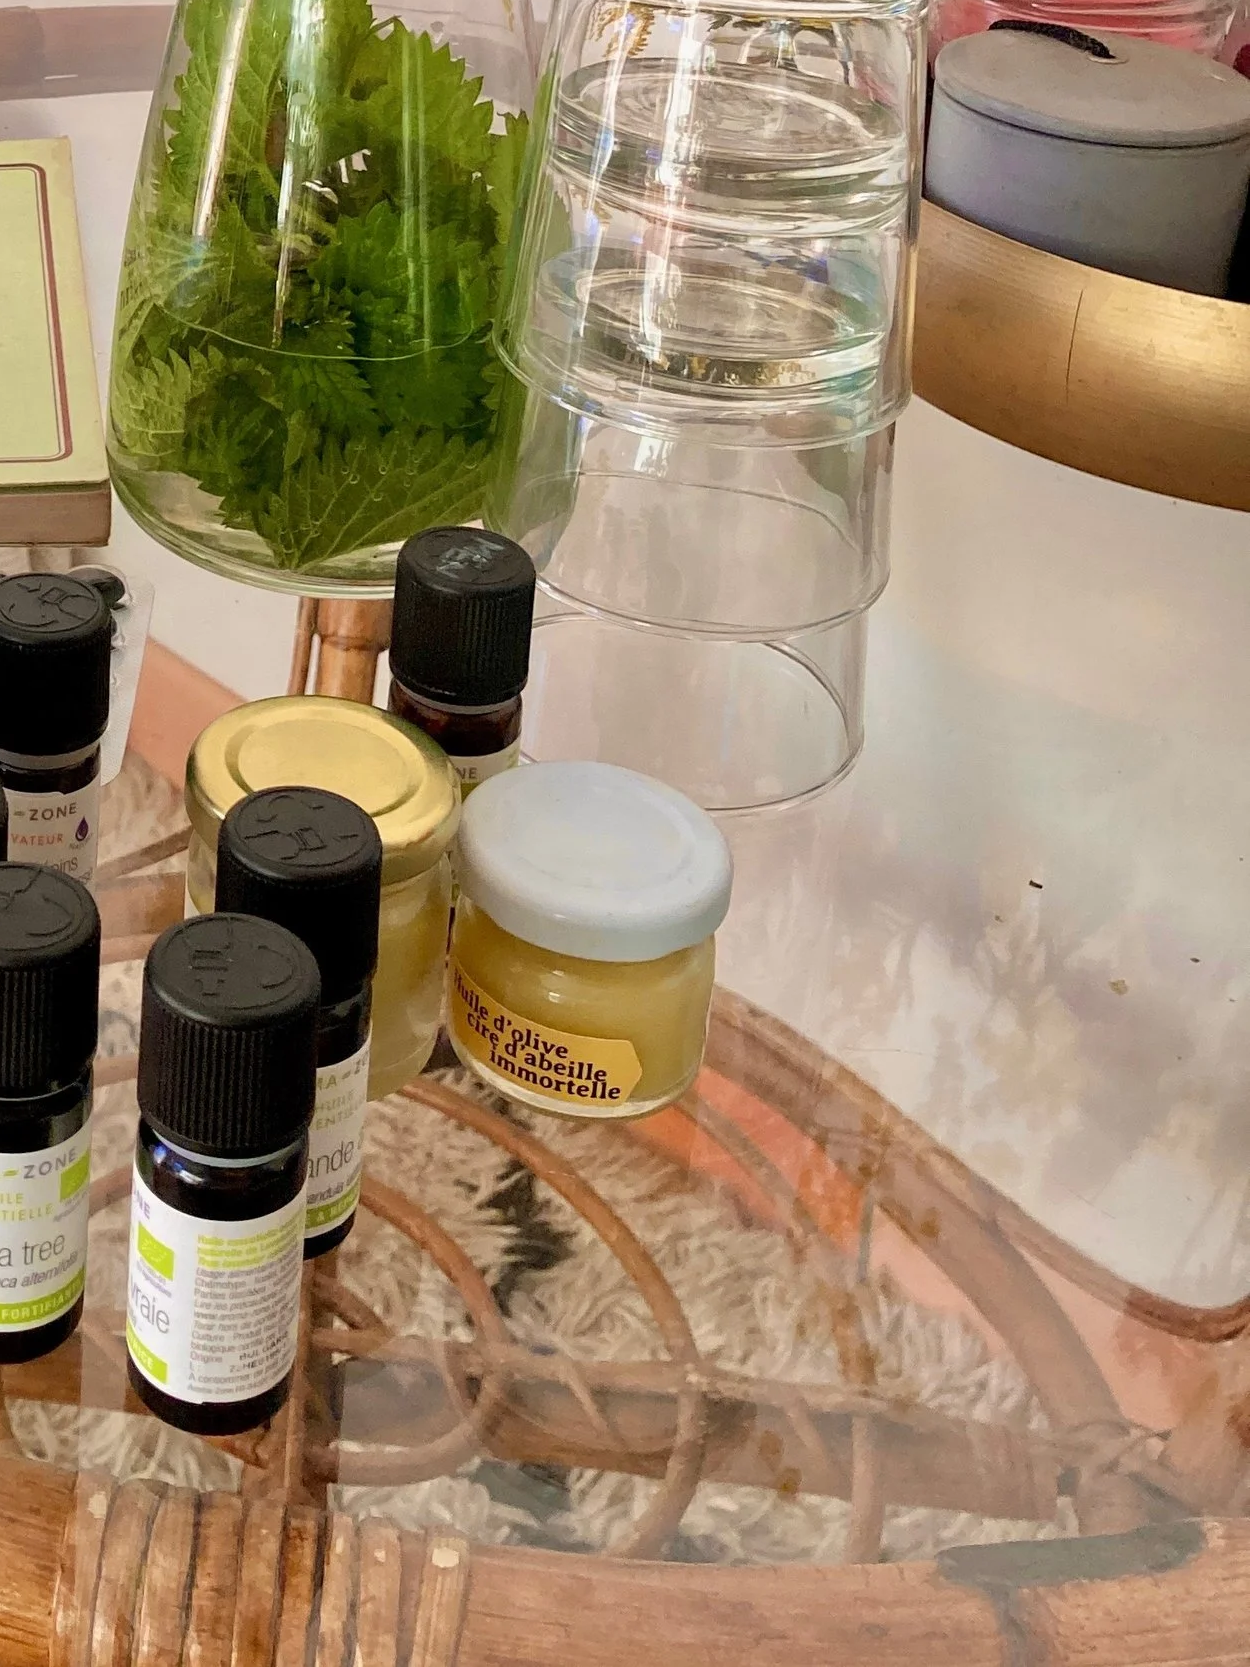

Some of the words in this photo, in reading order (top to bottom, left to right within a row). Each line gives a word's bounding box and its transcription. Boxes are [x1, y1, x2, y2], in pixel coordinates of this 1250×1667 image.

[28, 802, 77, 821] ZONE
[466, 1012, 500, 1047] cire
[504, 1036, 608, 1083] d'abeille
[493, 1013, 569, 1060] d'olive
[488, 1047, 622, 1100] immortelle
[23, 1147, 78, 1180] ZONE
[22, 1233, 66, 1265] tree
